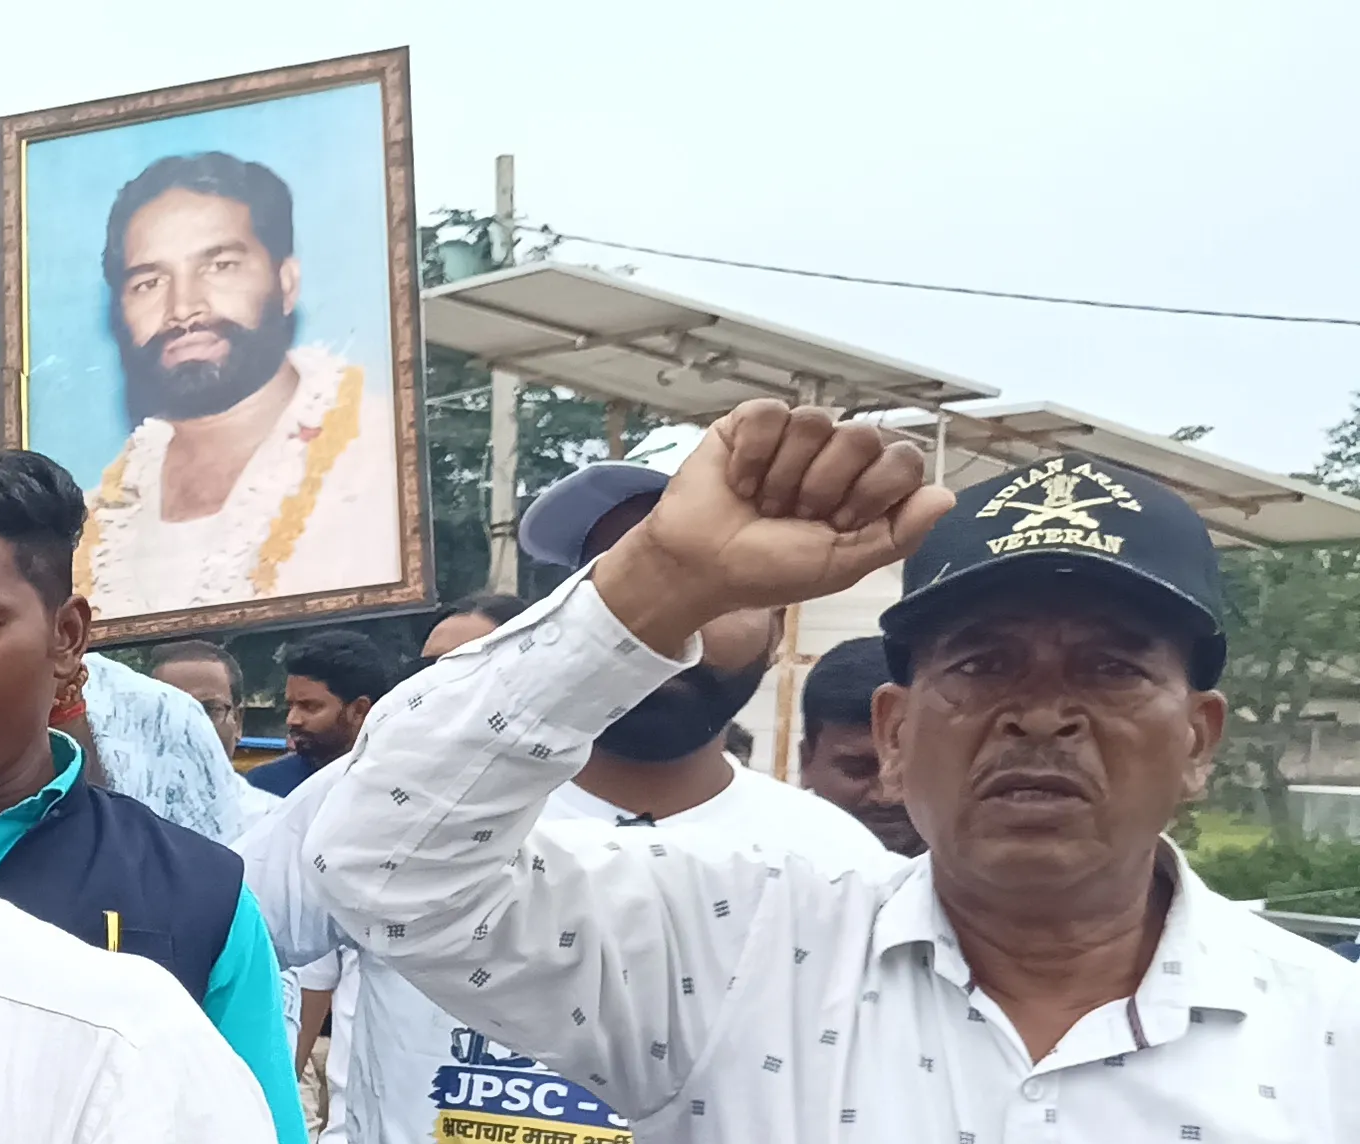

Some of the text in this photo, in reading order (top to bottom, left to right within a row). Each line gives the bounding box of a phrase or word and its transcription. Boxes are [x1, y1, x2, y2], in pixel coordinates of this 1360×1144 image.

[975, 458, 1144, 518] INDIAN ARMY
[986, 527, 1125, 554] VETERAN
[444, 1071, 569, 1116] JPSC
[442, 1116, 520, 1144] भ्रष्टाचार
